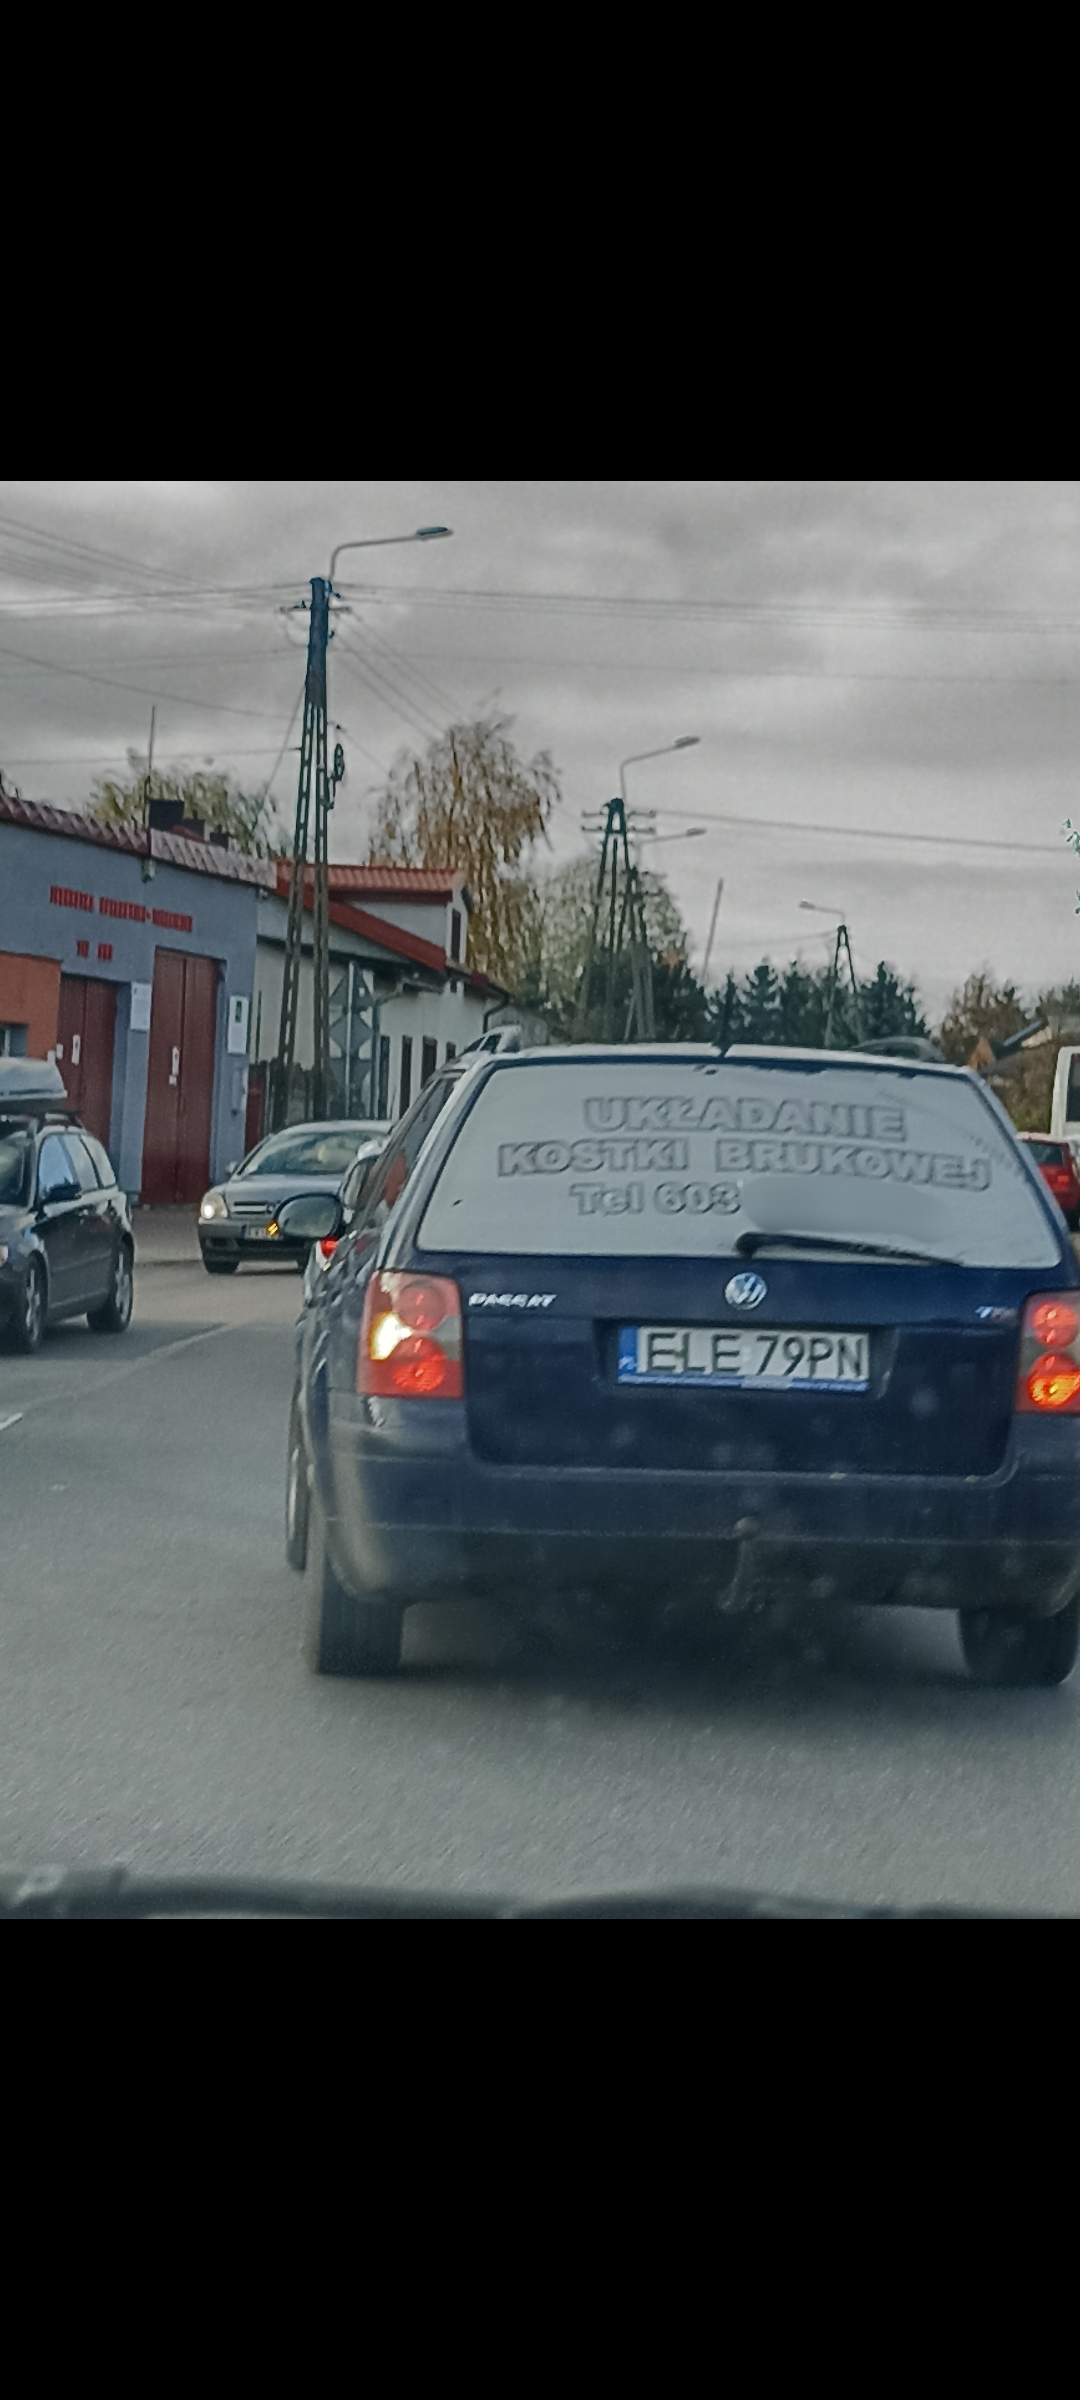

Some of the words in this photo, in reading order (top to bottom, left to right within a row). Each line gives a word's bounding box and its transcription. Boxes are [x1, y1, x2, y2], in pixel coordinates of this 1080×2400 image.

[583, 1096, 908, 1143] UKŁADANIE
[497, 1137, 689, 1177] KOSTKI
[715, 1138, 992, 1192] BRUKOWEJ
[647, 1332, 742, 1372] ELE
[756, 1335, 863, 1378] 79PN
